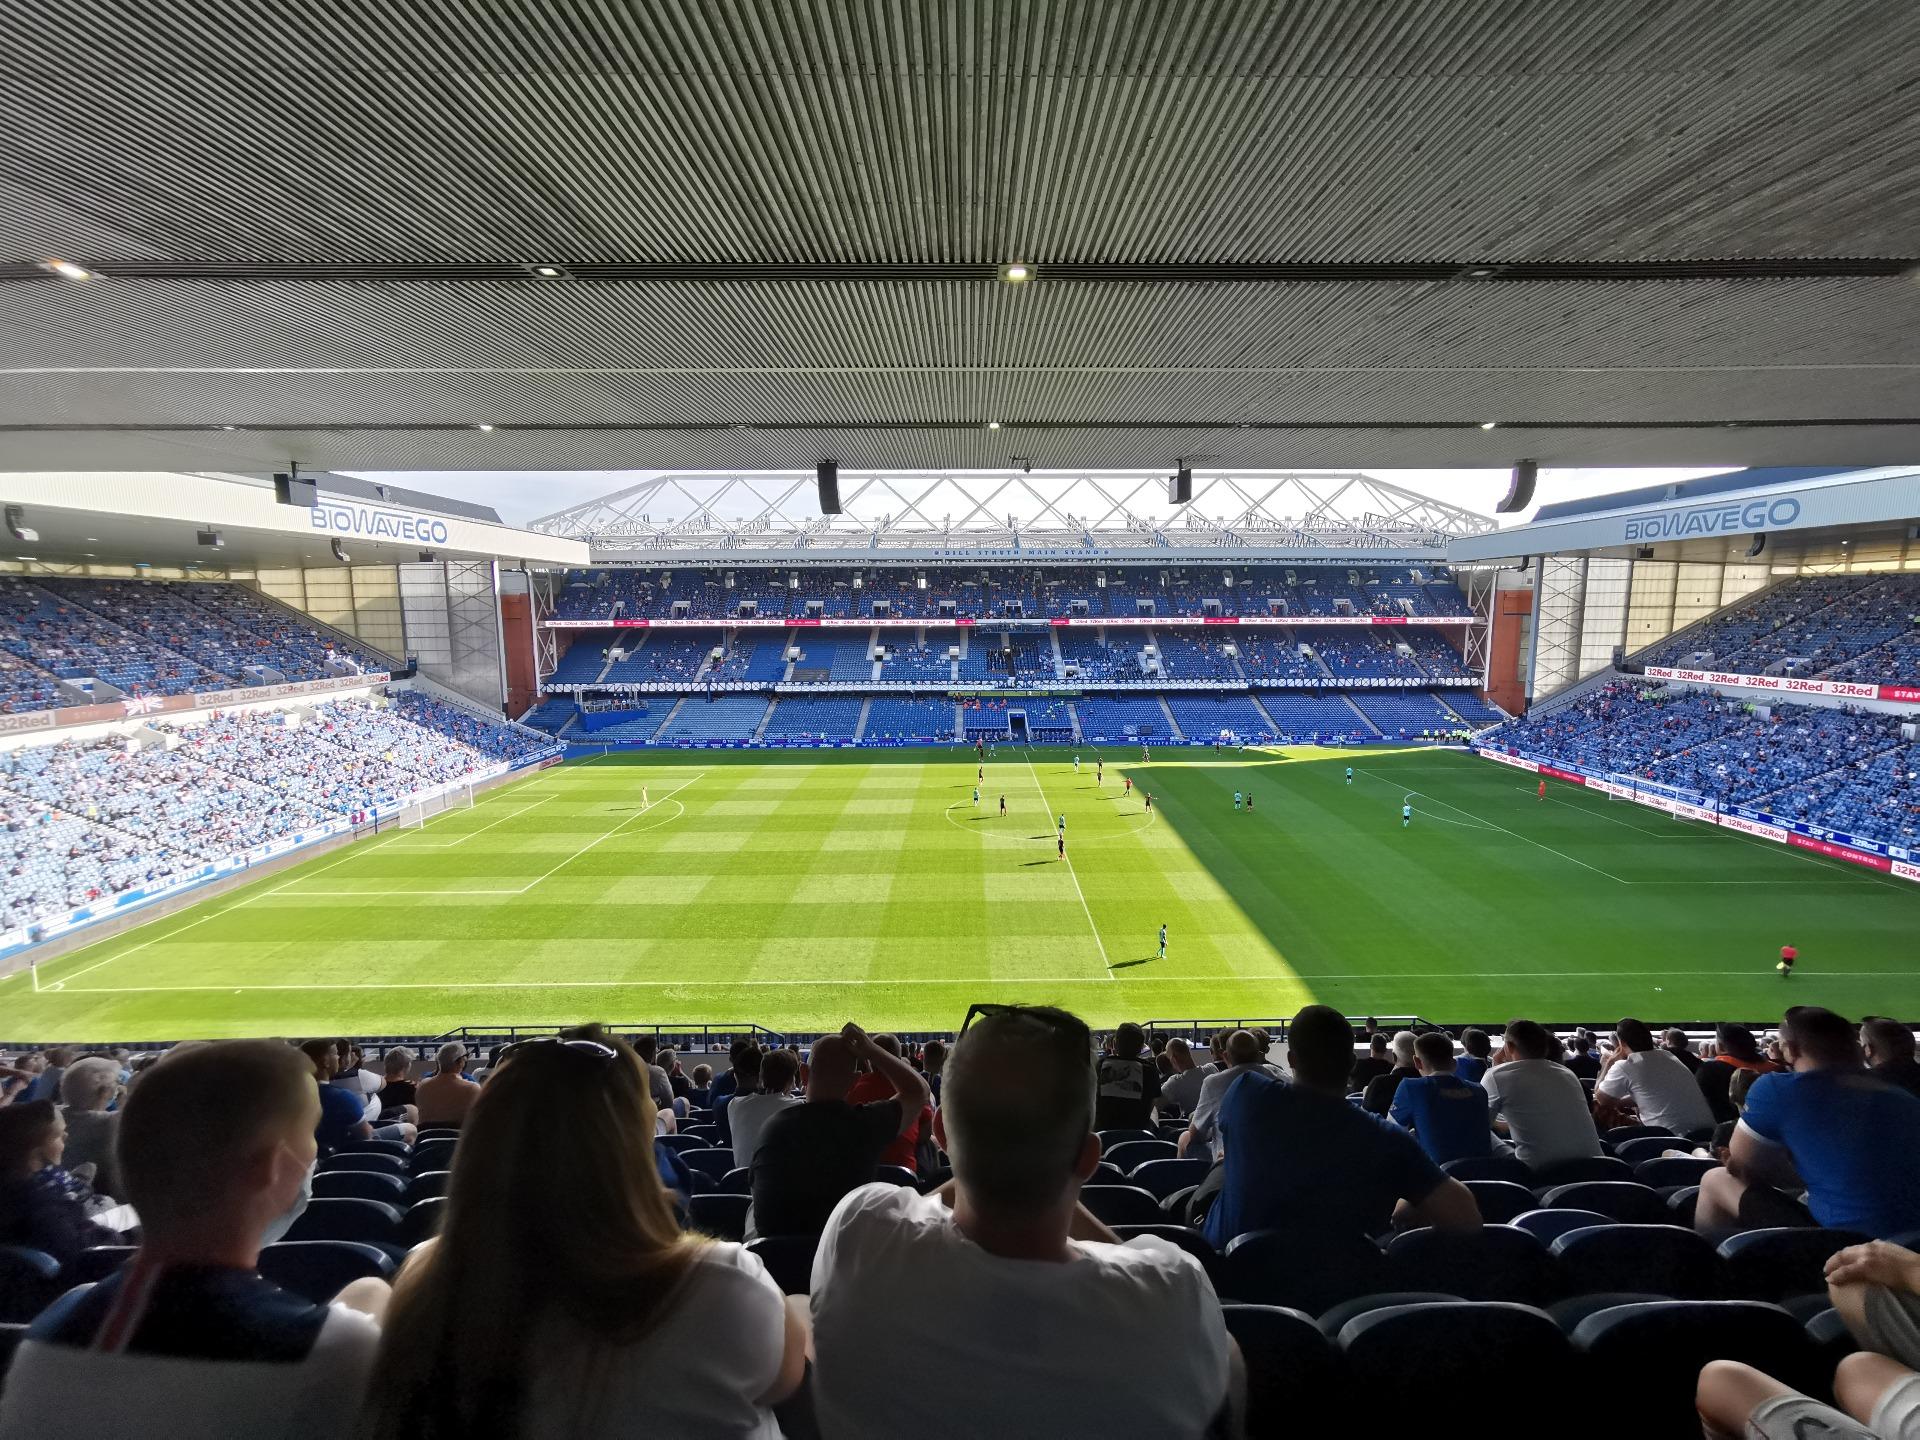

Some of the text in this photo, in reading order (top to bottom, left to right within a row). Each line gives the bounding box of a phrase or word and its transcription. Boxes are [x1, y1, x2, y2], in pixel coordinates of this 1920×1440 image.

[311, 502, 447, 543] BIOWAVEGO
[1625, 498, 1801, 540] BIOWAVEGO
[200, 692, 233, 705] 32Red
[240, 689, 270, 700] 32Red
[277, 685, 304, 696] 32Red
[309, 681, 335, 691] 32Red
[339, 677, 363, 687] 32Red
[1647, 668, 1920, 698] 32Red 32Red 32Red 32Red 32Red 32Red STAY
[0, 713, 50, 730] 32Red
[1727, 818, 1753, 831] 32Red
[1757, 825, 1785, 840] 32Red
[1737, 808, 1879, 851] 32Red 32Red 32Rd 32Red
[1797, 838, 1815, 847] STAY
[1841, 850, 1879, 866] CONTROL
